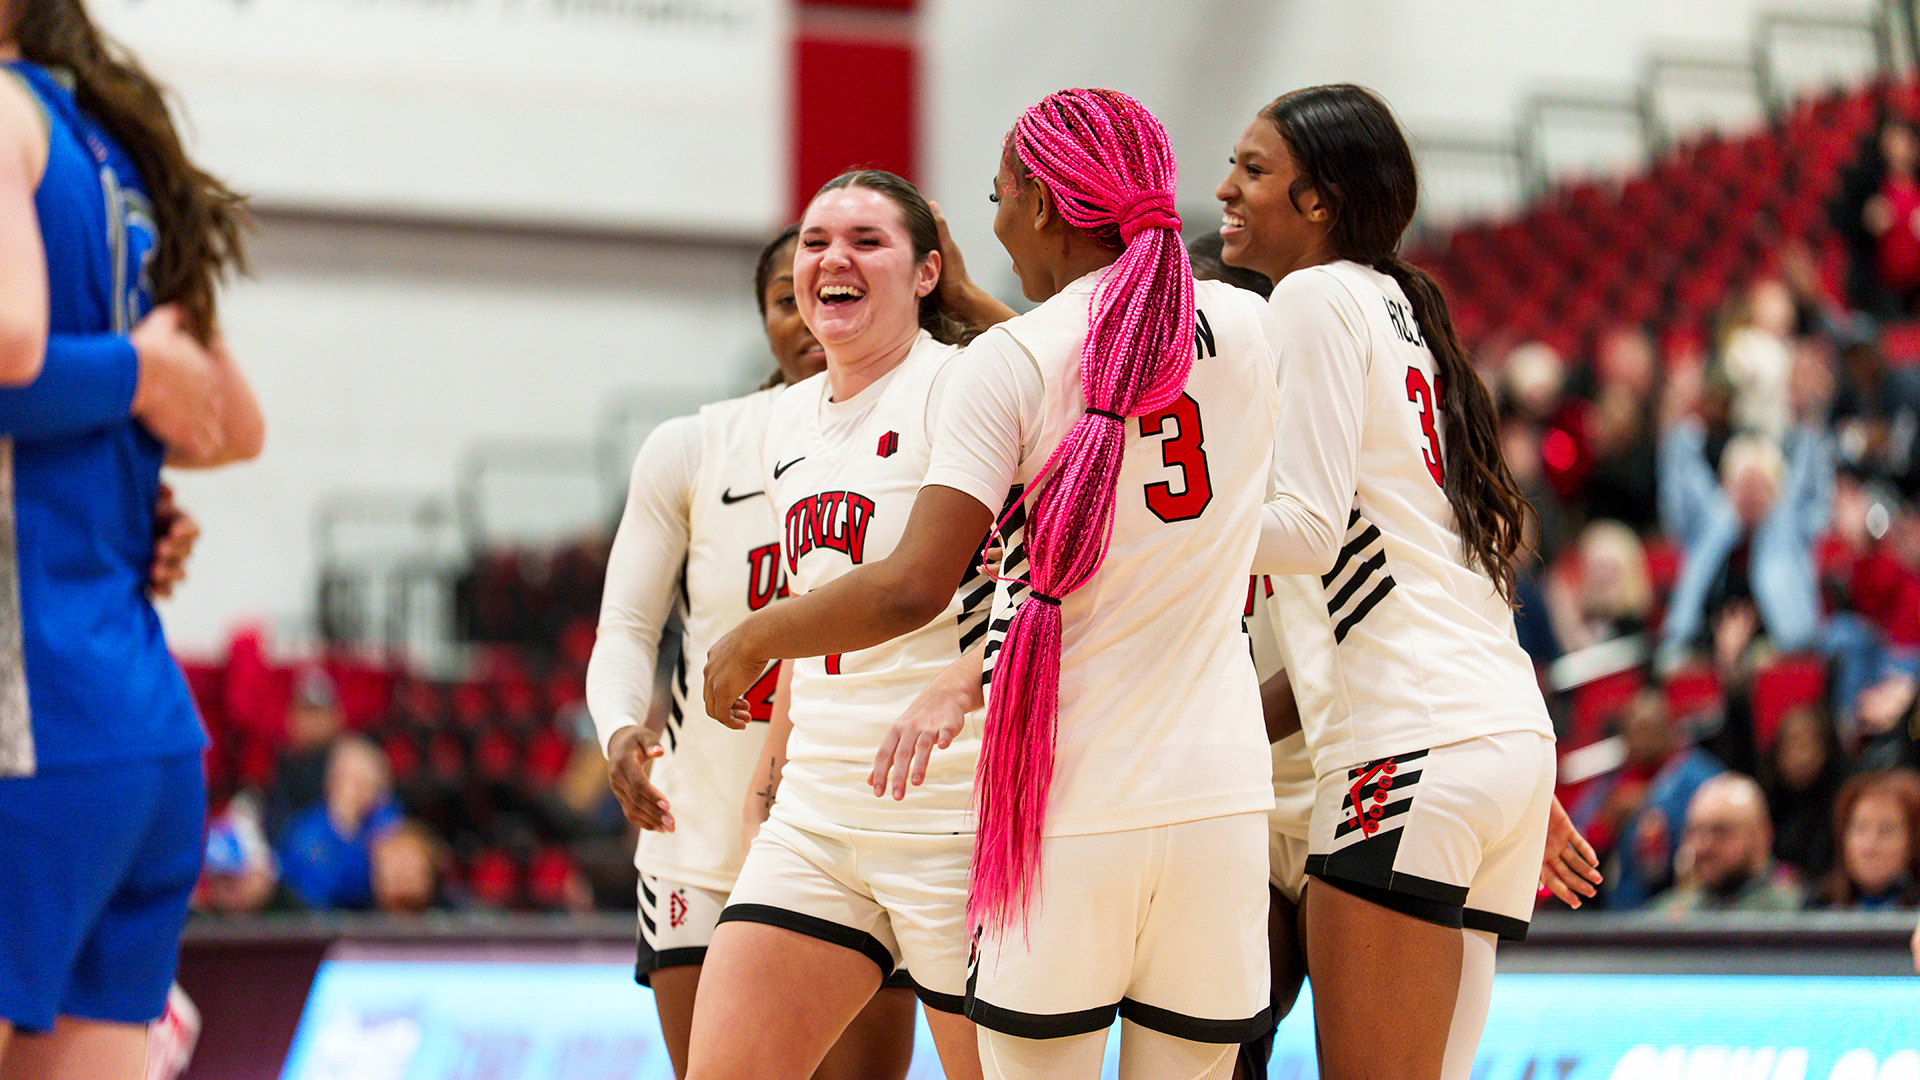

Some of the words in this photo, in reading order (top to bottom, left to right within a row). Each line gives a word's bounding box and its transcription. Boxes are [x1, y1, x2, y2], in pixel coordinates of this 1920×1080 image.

[1138, 390, 1213, 523] 3
[1405, 365, 1446, 488] 3
[785, 490, 876, 576] UNLV
[746, 541, 790, 612] U
[1365, 762, 1397, 832] VEGAS
